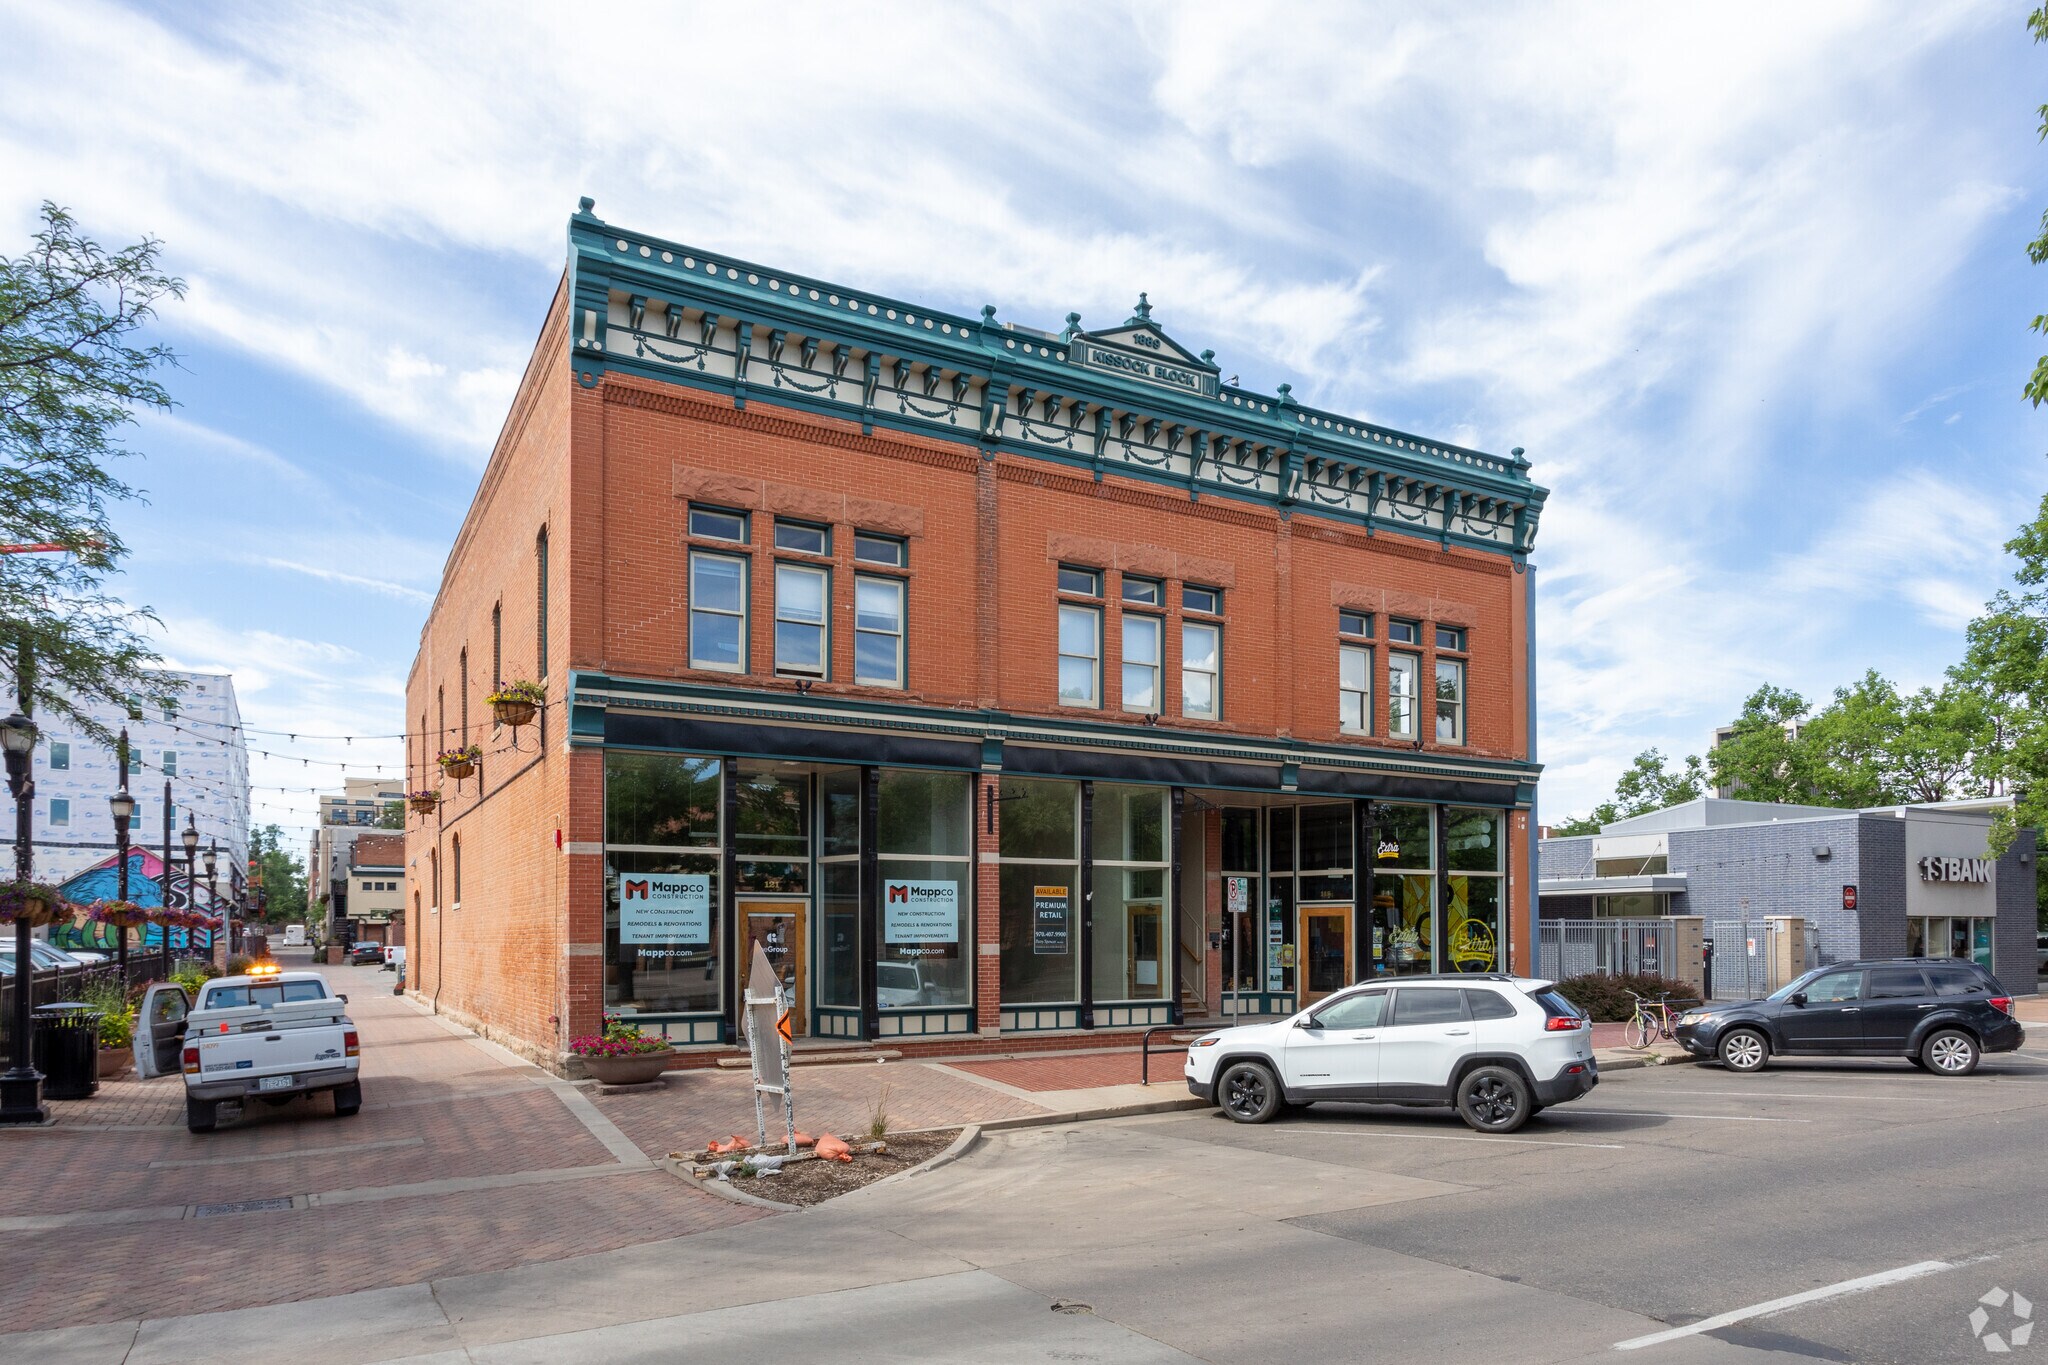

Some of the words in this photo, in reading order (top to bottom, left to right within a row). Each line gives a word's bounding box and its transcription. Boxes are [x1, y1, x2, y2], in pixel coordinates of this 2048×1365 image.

[1133, 333, 1160, 350] 1889
[1092, 350, 1150, 376] KISSOCK
[1154, 366, 1195, 386] BLOCK
[652, 882, 704, 894] Mappco
[911, 886, 953, 898] Mappco
[638, 949, 692, 958] Mappco.com
